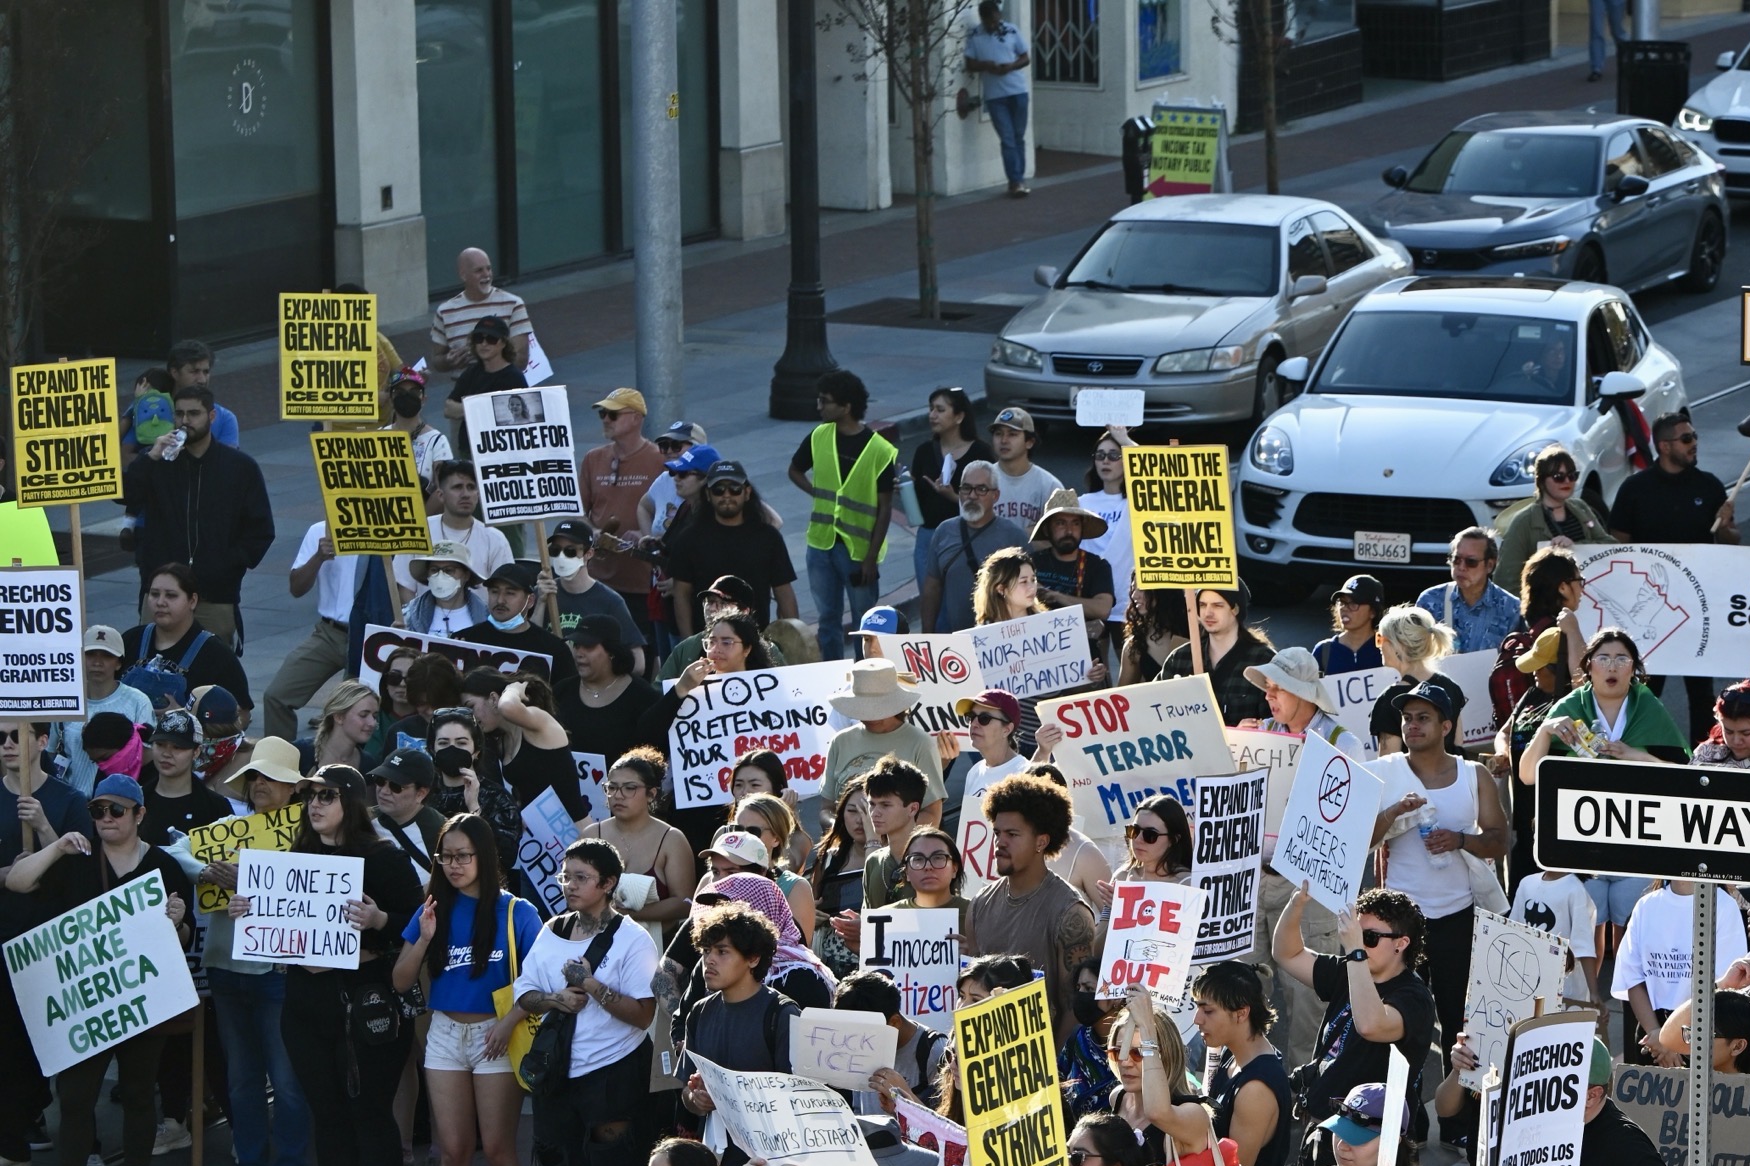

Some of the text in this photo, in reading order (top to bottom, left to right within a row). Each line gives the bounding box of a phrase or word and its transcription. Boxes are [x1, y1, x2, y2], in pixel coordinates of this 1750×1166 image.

[1161, 139, 1206, 155] INCOME TAX
[1183, 158, 1211, 172] PUBLIC
[284, 299, 371, 321] EXPAND THE
[284, 323, 371, 351] GENERAL
[16, 365, 110, 397] EXPAND THE
[291, 360, 366, 389] STRIKE!
[18, 391, 112, 431] GENERAL
[286, 392, 373, 402] ICE OUT!
[26, 434, 108, 473] STRIKE!
[315, 436, 409, 460] EXPAND THE
[476, 425, 569, 454] JUSTICE FOR
[21, 467, 116, 487] ICE OUT!
[321, 460, 415, 490] GENERAL
[480, 459, 573, 480] RENEE
[1128, 453, 1222, 477] EXPAND THE
[483, 479, 537, 503] NICOLE
[538, 476, 576, 498] GOOD
[1131, 479, 1225, 512] GENERAL
[336, 496, 417, 526] STRIKE!
[335, 527, 425, 539] ICE OUT!
[1142, 522, 1223, 554] STRIKE!
[1140, 557, 1231, 568] ICE OUT!
[1358, 542, 1406, 558] 8RSJ663
[1142, 573, 1232, 582] PARTY FOR SOCIALISM & LIBERATION
[1000, 622, 1028, 640] FIGHT
[901, 640, 971, 684] NO
[1009, 660, 1026, 674] NOT
[676, 705, 827, 751] PRETENDING
[1056, 694, 1130, 738] STOP
[677, 732, 800, 771] YOUR RACISM
[1083, 730, 1194, 776] TERROR
[684, 774, 713, 802] IS
[1573, 795, 1661, 841] ONE
[1297, 815, 1347, 868] QUEERS
[247, 864, 352, 895] NO ONE IS
[1284, 837, 1349, 903] AGAINST FASCISM
[242, 895, 317, 919] ILLEGAL
[1113, 886, 1181, 934] ICE
[7, 876, 164, 974] IMMIGRANTS
[243, 925, 357, 956] STOLEN LAND
[865, 915, 954, 968] Innocent
[55, 927, 128, 984] MAKE
[1111, 959, 1170, 988] OUT
[47, 954, 159, 1028] AMERICA
[68, 994, 149, 1055] GREAT
[804, 1026, 876, 1051] FUCK
[960, 991, 1046, 1060] EXPAND THE
[817, 1051, 867, 1074] ICE
[966, 1035, 1054, 1116] GENERAL
[736, 1075, 786, 1092] FAMILIES
[1616, 1069, 1685, 1108] GOKU
[744, 1098, 850, 1113] PEOPLE MURDERED!
[757, 1124, 864, 1152] TRUMP'S GESTAPO!
